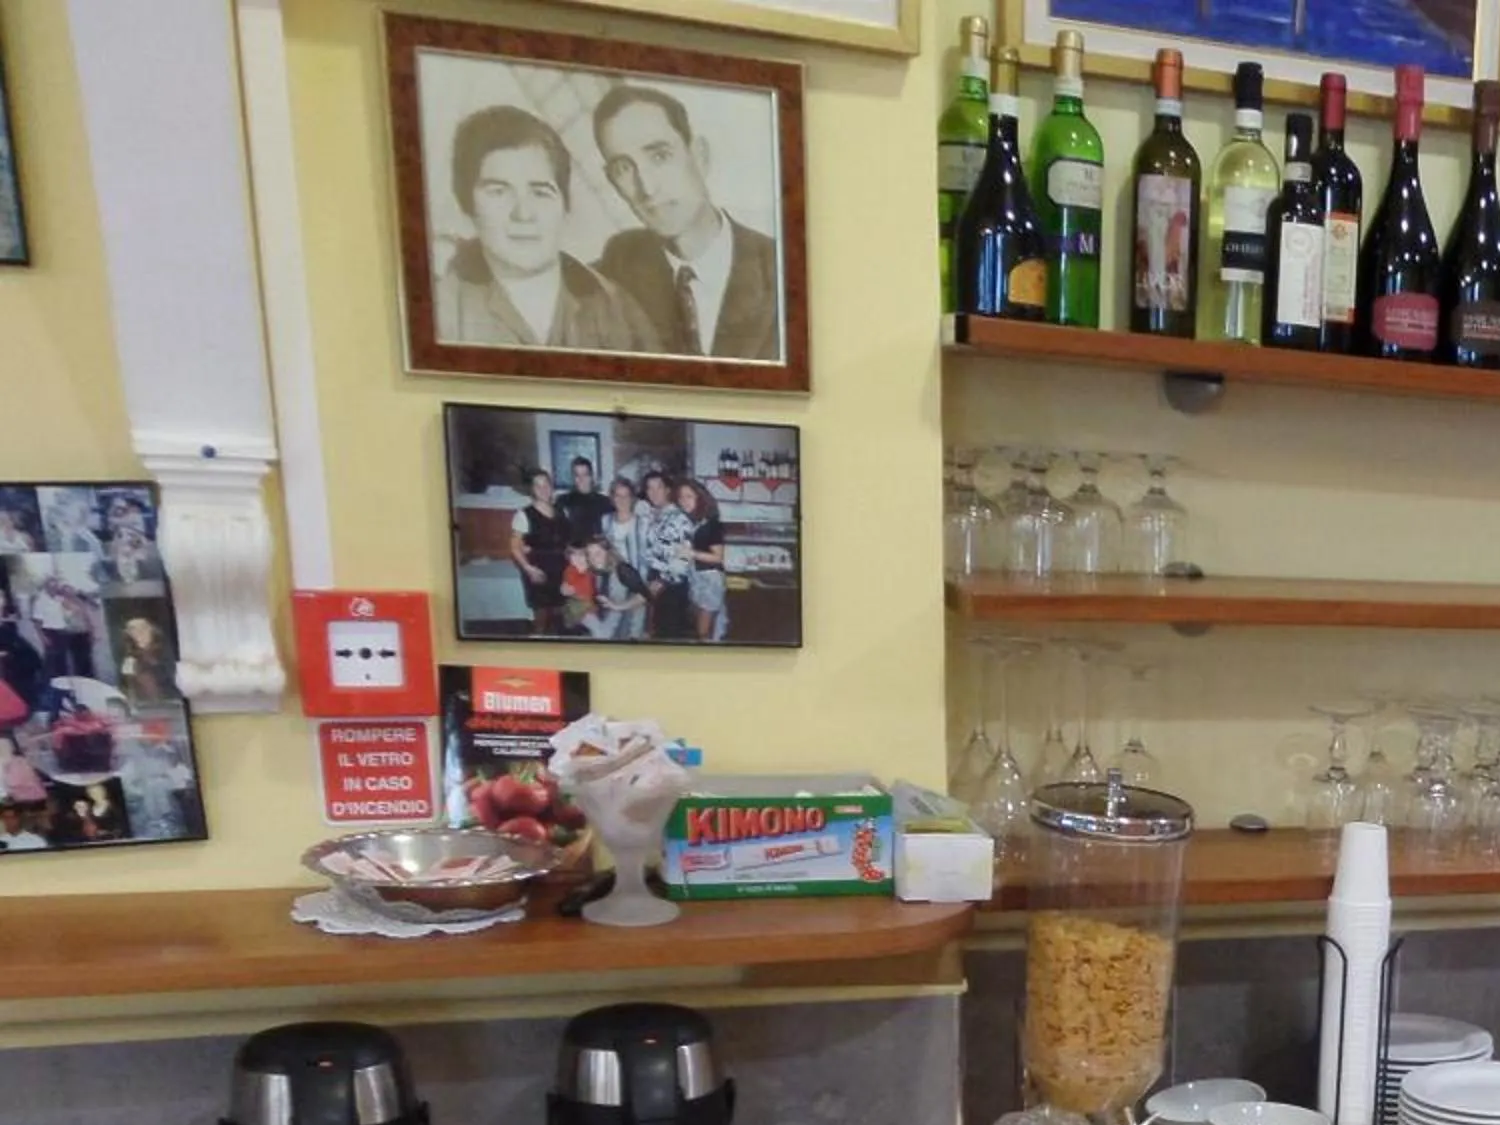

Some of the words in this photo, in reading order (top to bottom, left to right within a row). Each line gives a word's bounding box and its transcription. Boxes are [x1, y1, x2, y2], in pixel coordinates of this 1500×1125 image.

[483, 691, 552, 712] Blumen
[331, 727, 417, 743] ROMPERE
[338, 752, 354, 766] IL
[356, 751, 414, 766] VETRO
[343, 777, 361, 791] IN
[365, 776, 412, 791] CASO
[332, 800, 429, 817] D'INCENDIO
[686, 806, 826, 847] KIMONO
